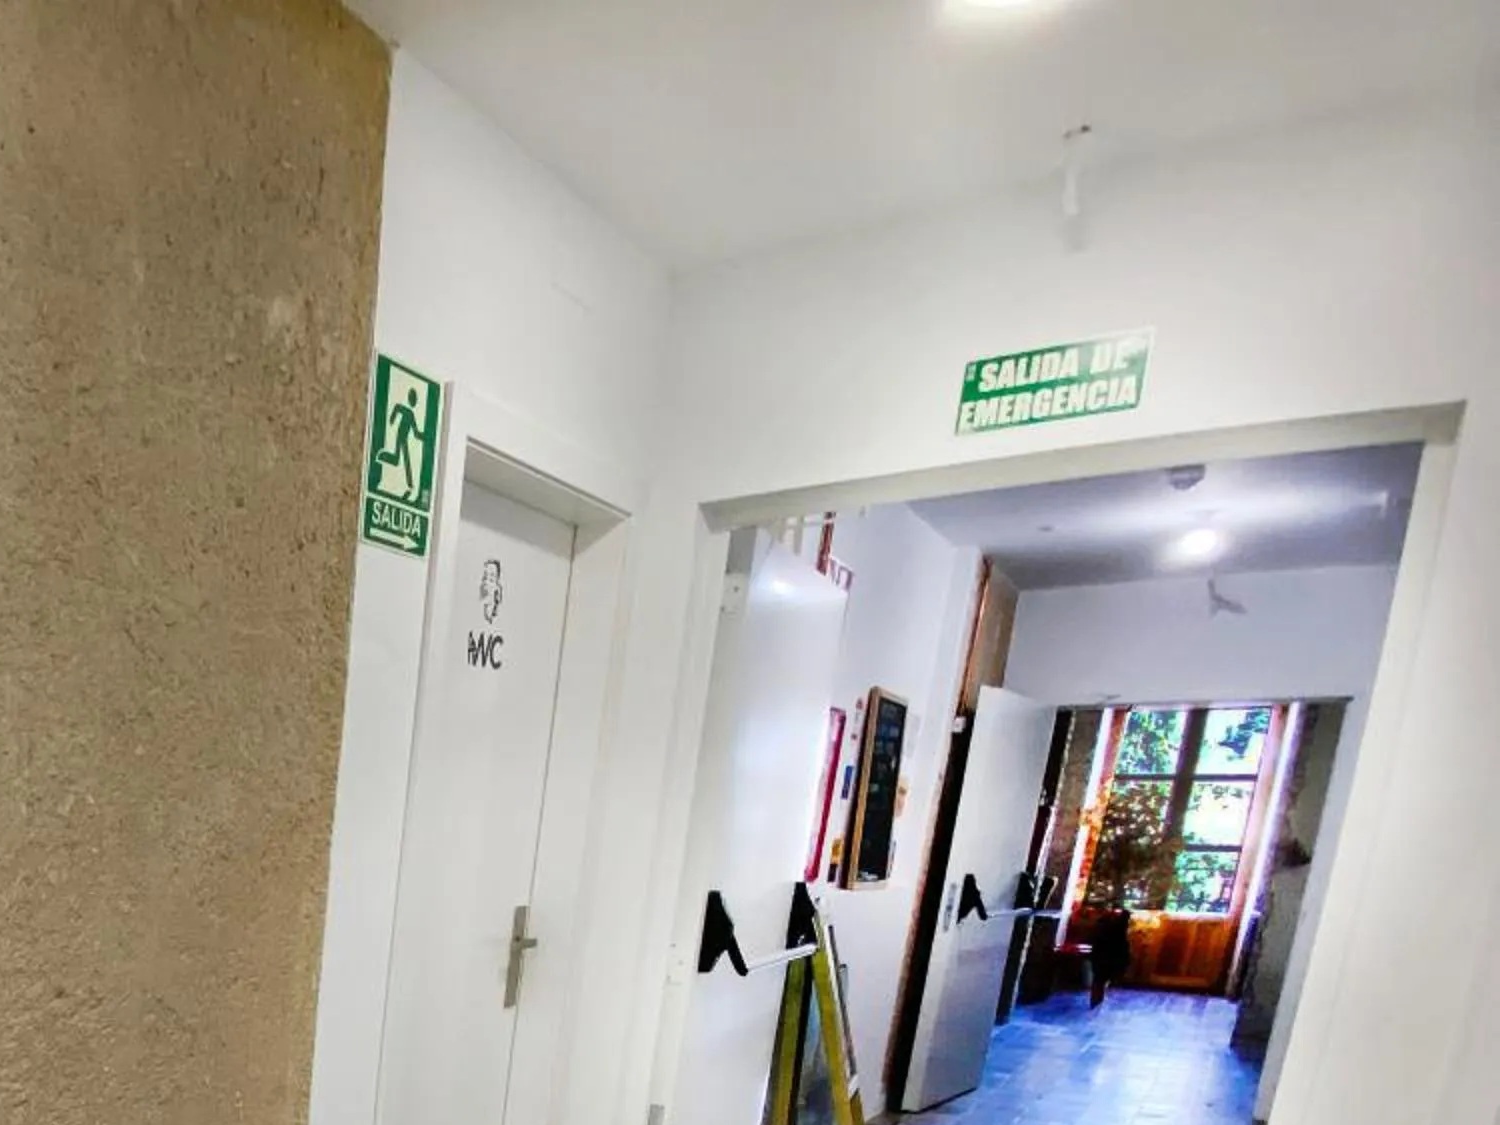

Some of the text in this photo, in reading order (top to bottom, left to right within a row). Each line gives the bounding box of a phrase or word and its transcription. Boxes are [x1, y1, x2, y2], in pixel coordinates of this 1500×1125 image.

[977, 337, 1148, 393] SALIDA DE
[959, 374, 1138, 432] EMERGENCIA
[371, 501, 421, 538] SALIDA
